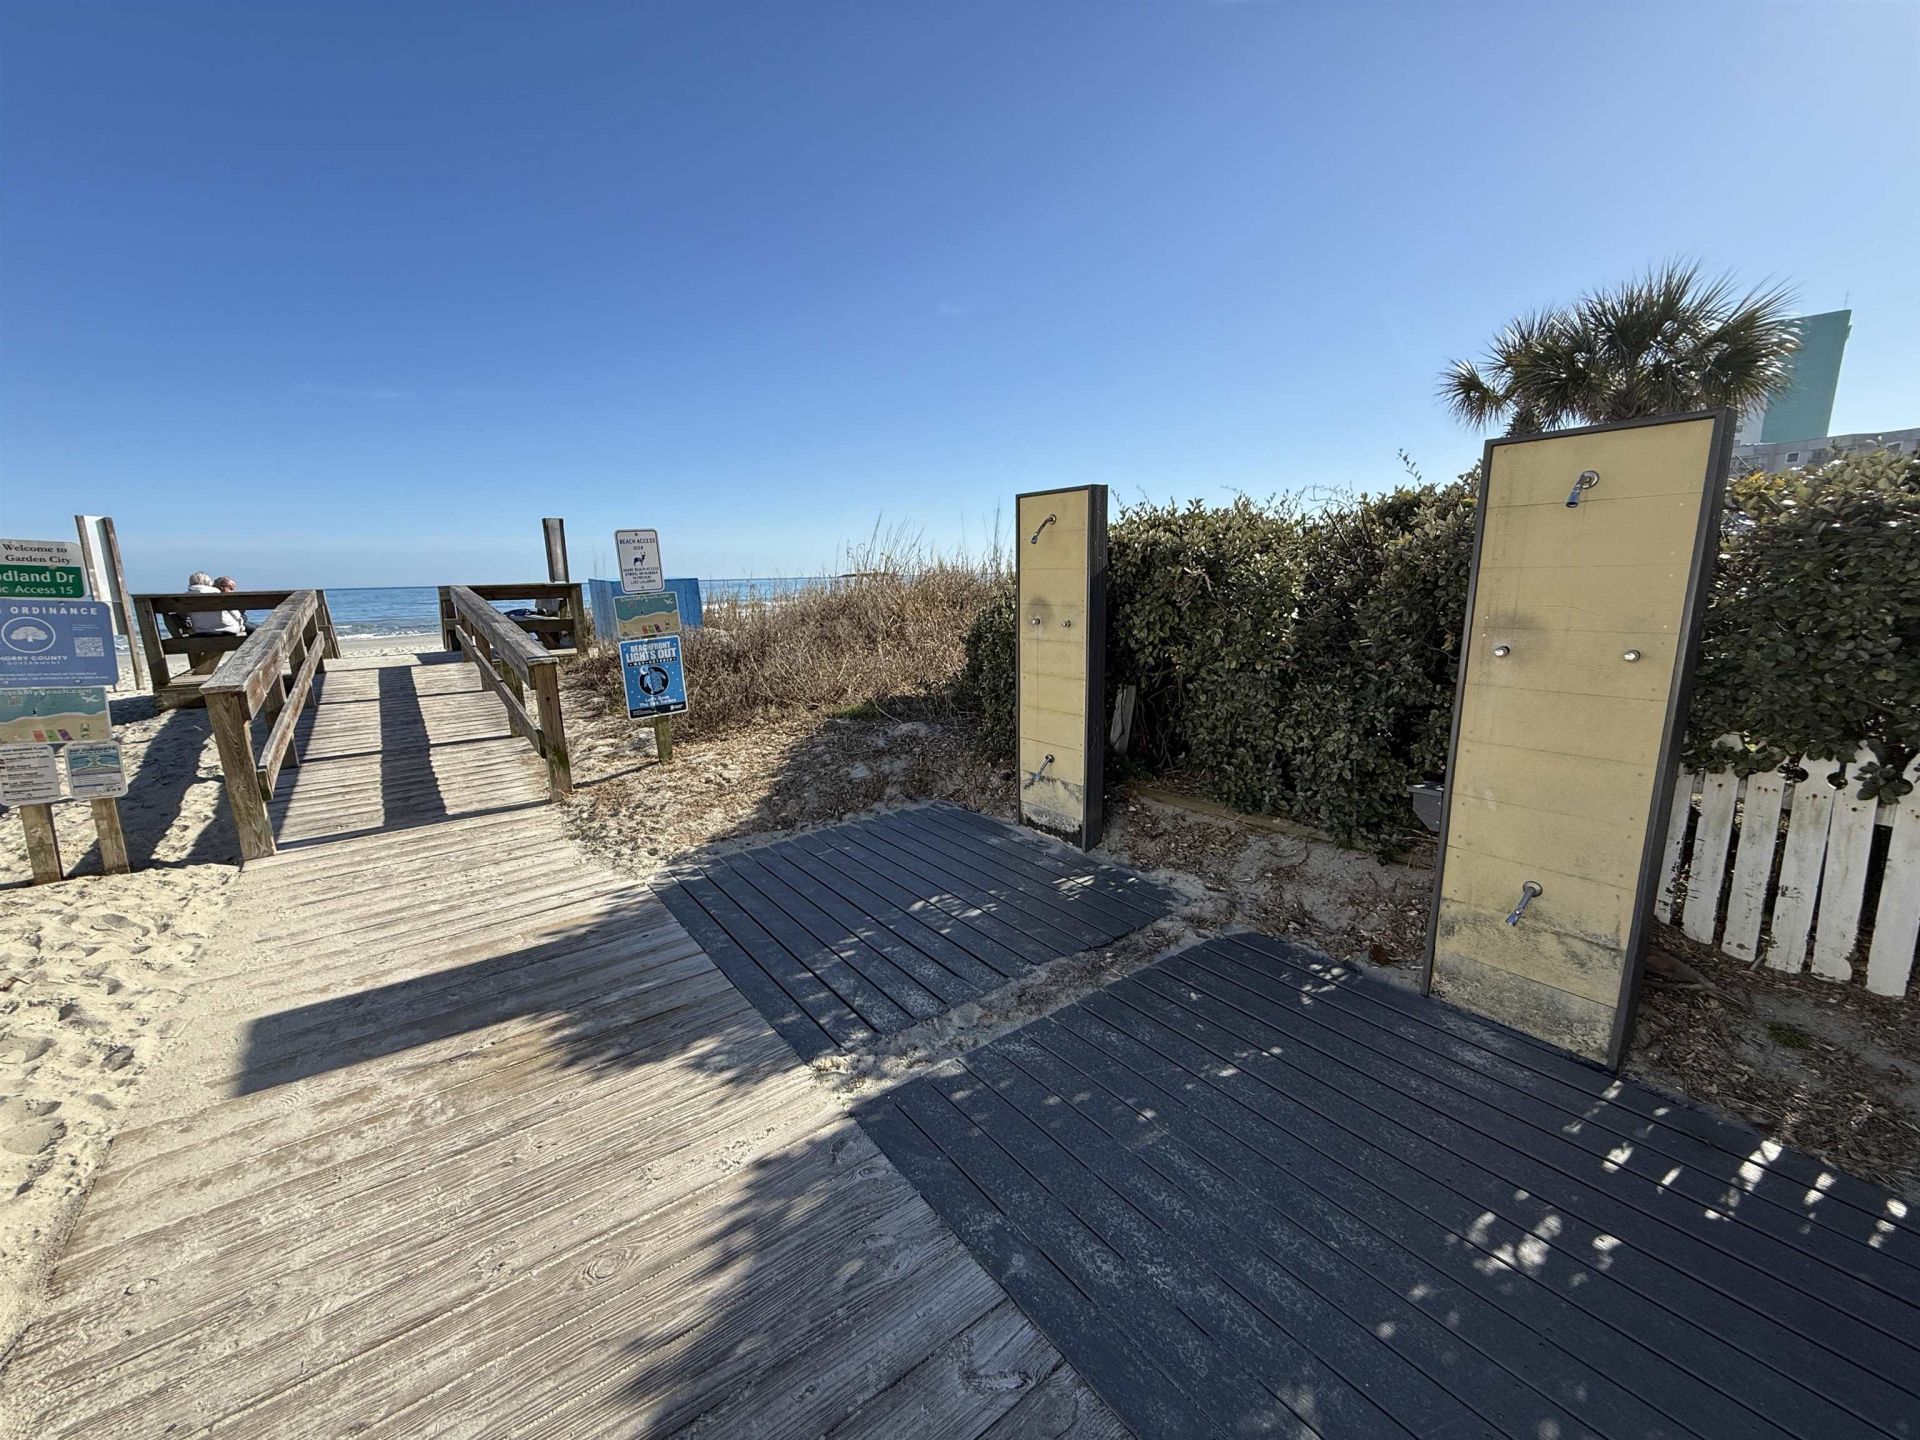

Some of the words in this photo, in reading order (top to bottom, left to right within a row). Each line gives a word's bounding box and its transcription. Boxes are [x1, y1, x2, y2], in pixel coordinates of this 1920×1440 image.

[2, 543, 54, 553] Welcome
[5, 554, 47, 563] Garden
[49, 555, 72, 565] City
[0, 570, 51, 583] dland
[55, 571, 75, 583] Dr
[15, 585, 56, 594] Access
[60, 586, 74, 595] 15
[10, 606, 98, 616] ORDINANCE
[630, 641, 671, 653] BEACHFRONT
[625, 650, 656, 663] LIGHTS
[657, 647, 677, 659] OUT
